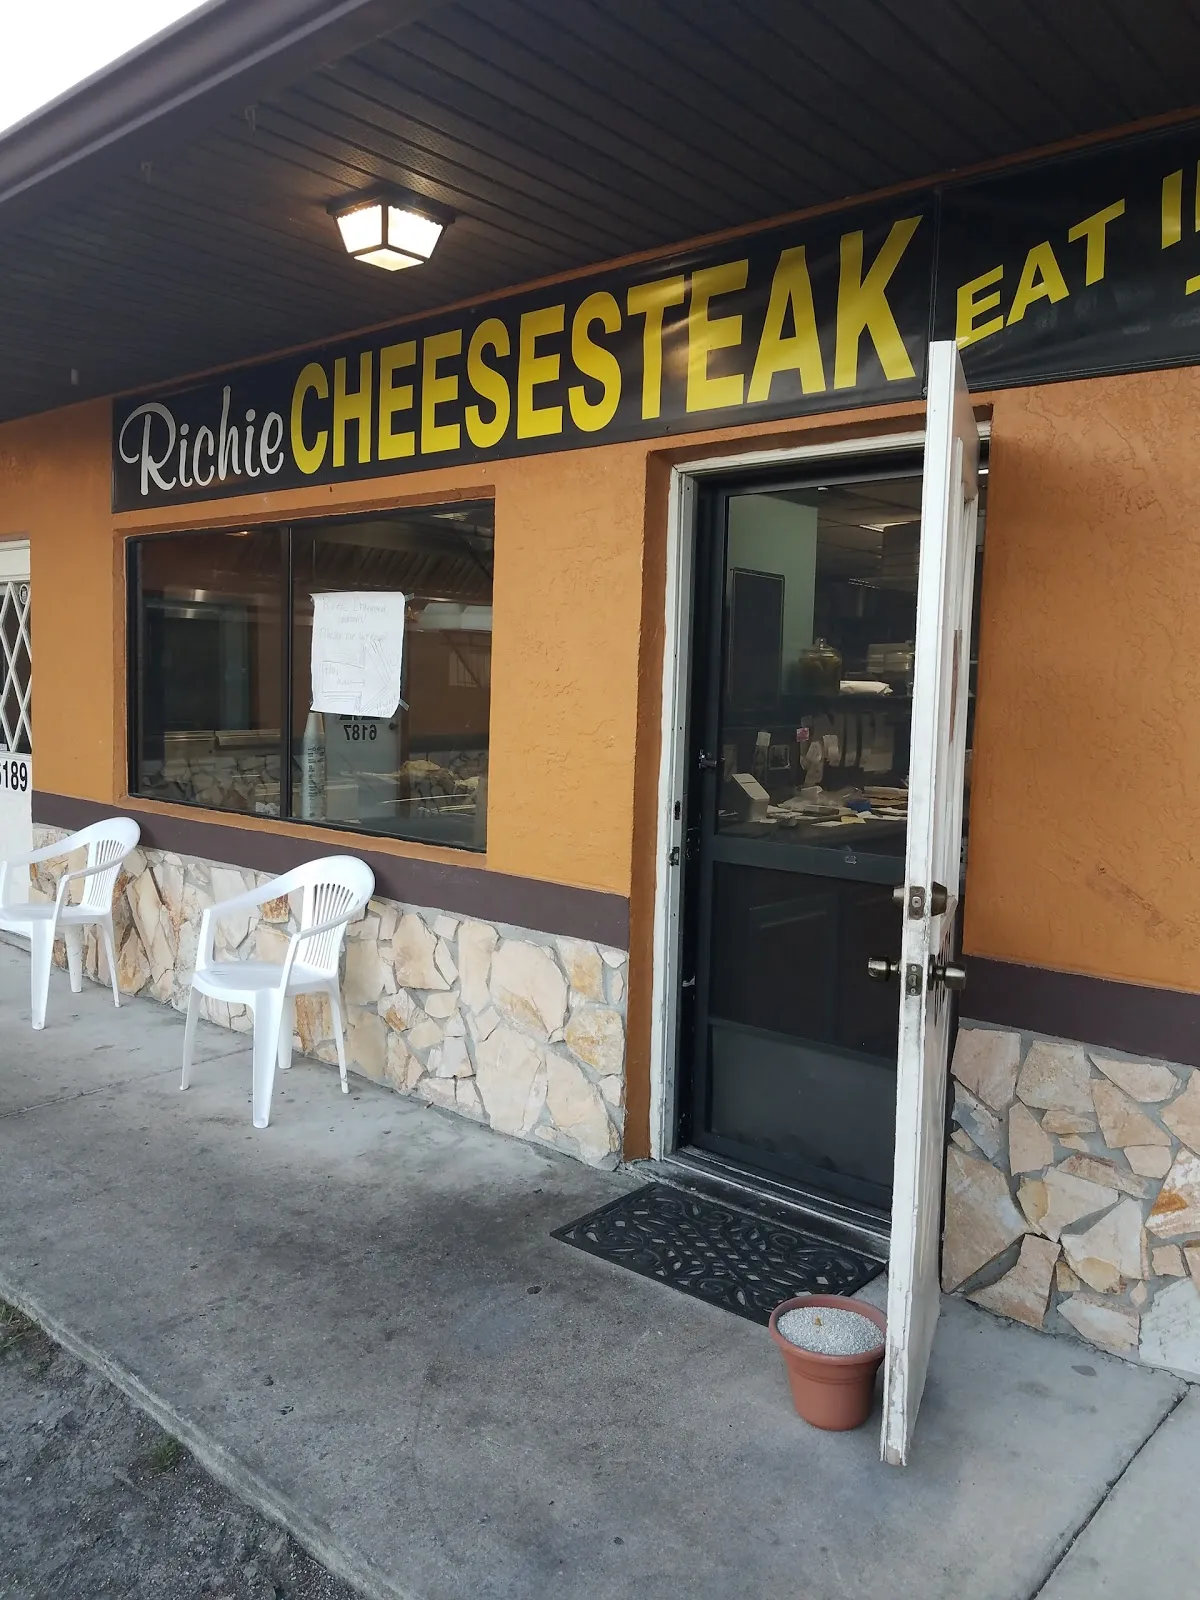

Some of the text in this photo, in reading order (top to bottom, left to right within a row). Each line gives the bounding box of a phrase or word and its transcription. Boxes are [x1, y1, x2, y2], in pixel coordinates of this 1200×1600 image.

[956, 159, 1200, 349] EAT I
[119, 215, 923, 496] Richie CHEESESTEAK
[0, 760, 28, 792] 189
